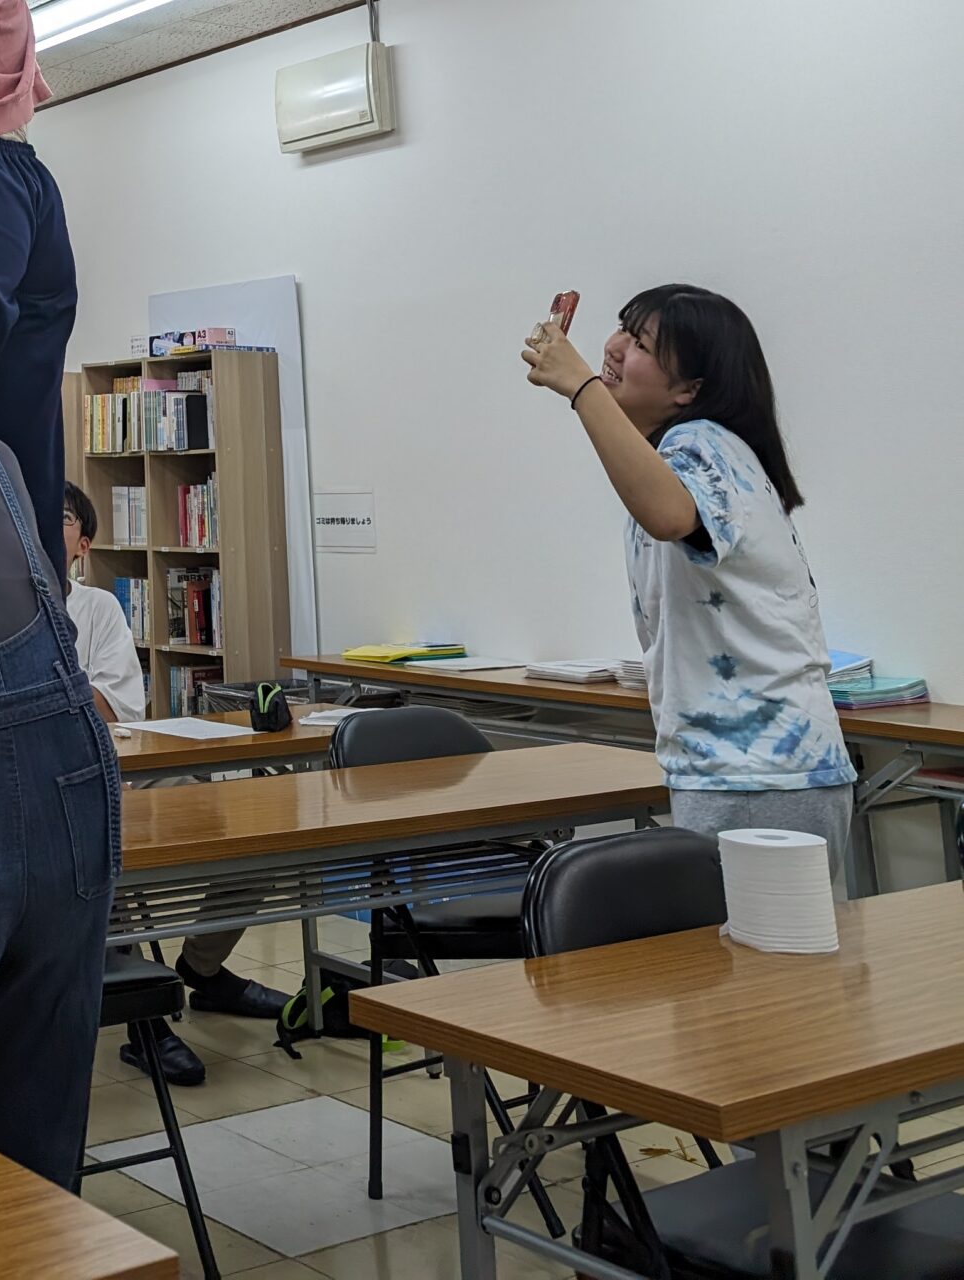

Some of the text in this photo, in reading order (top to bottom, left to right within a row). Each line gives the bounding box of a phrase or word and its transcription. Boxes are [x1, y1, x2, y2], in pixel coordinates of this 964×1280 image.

[197, 330, 207, 339] A3
[316, 517, 372, 526] ゴミは持ち帰りましょう
